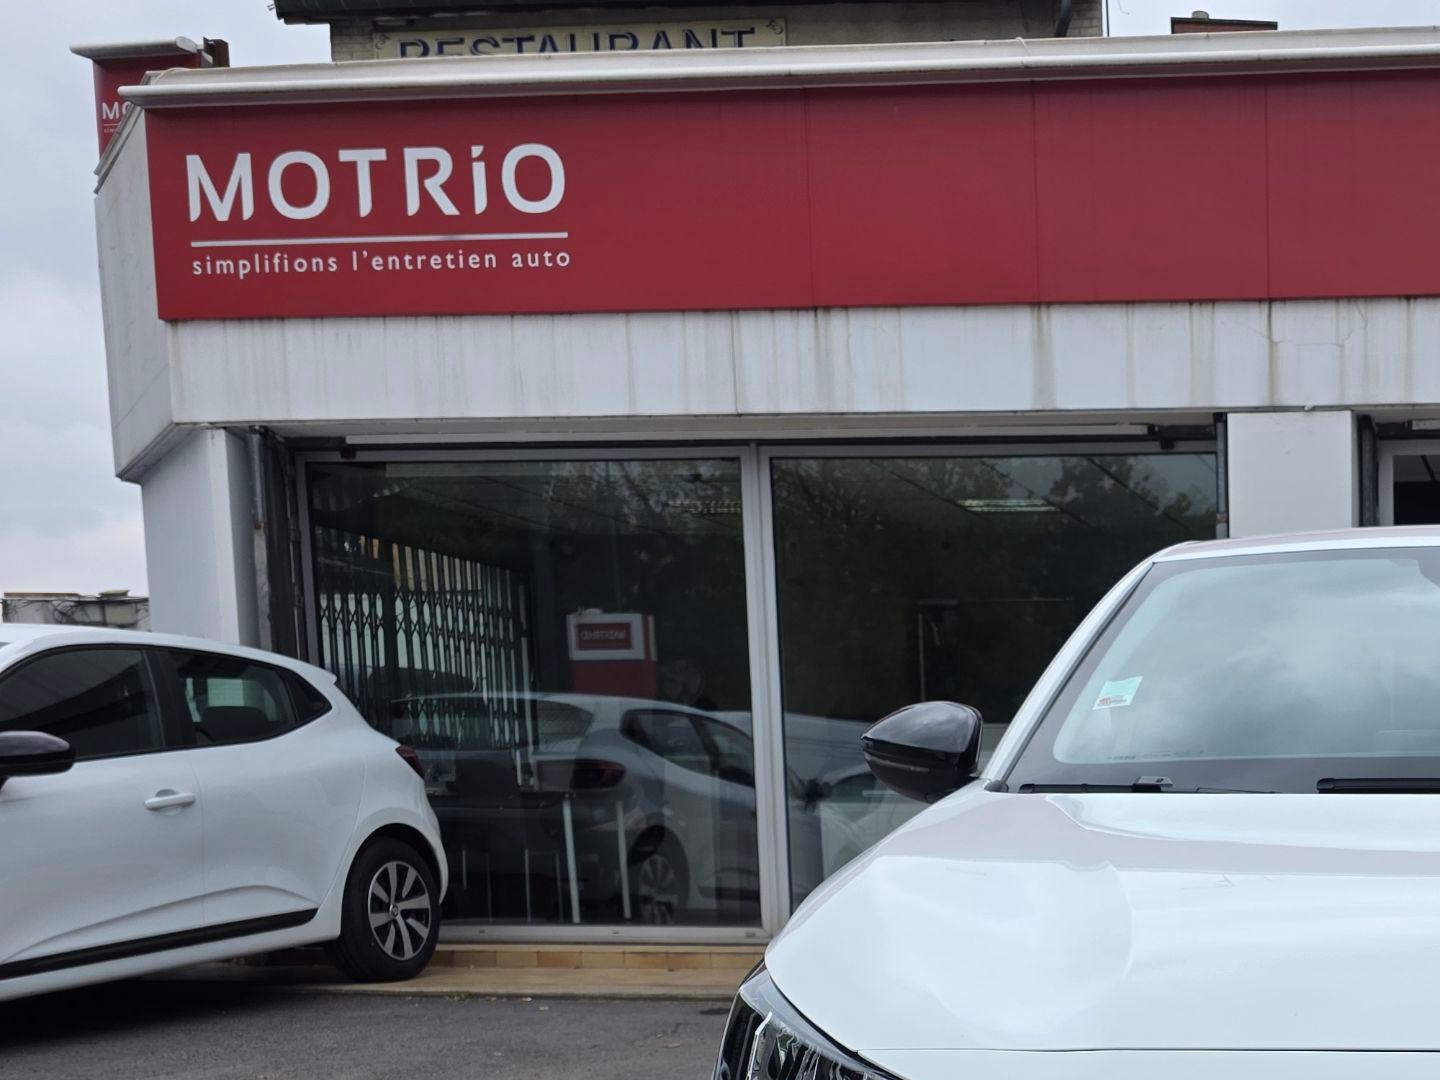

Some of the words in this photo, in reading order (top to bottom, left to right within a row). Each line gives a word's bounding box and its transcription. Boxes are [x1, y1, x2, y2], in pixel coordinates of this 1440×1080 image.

[192, 250, 339, 280] simplifions
[352, 249, 498, 272] l'entretien
[511, 249, 571, 269] auto
